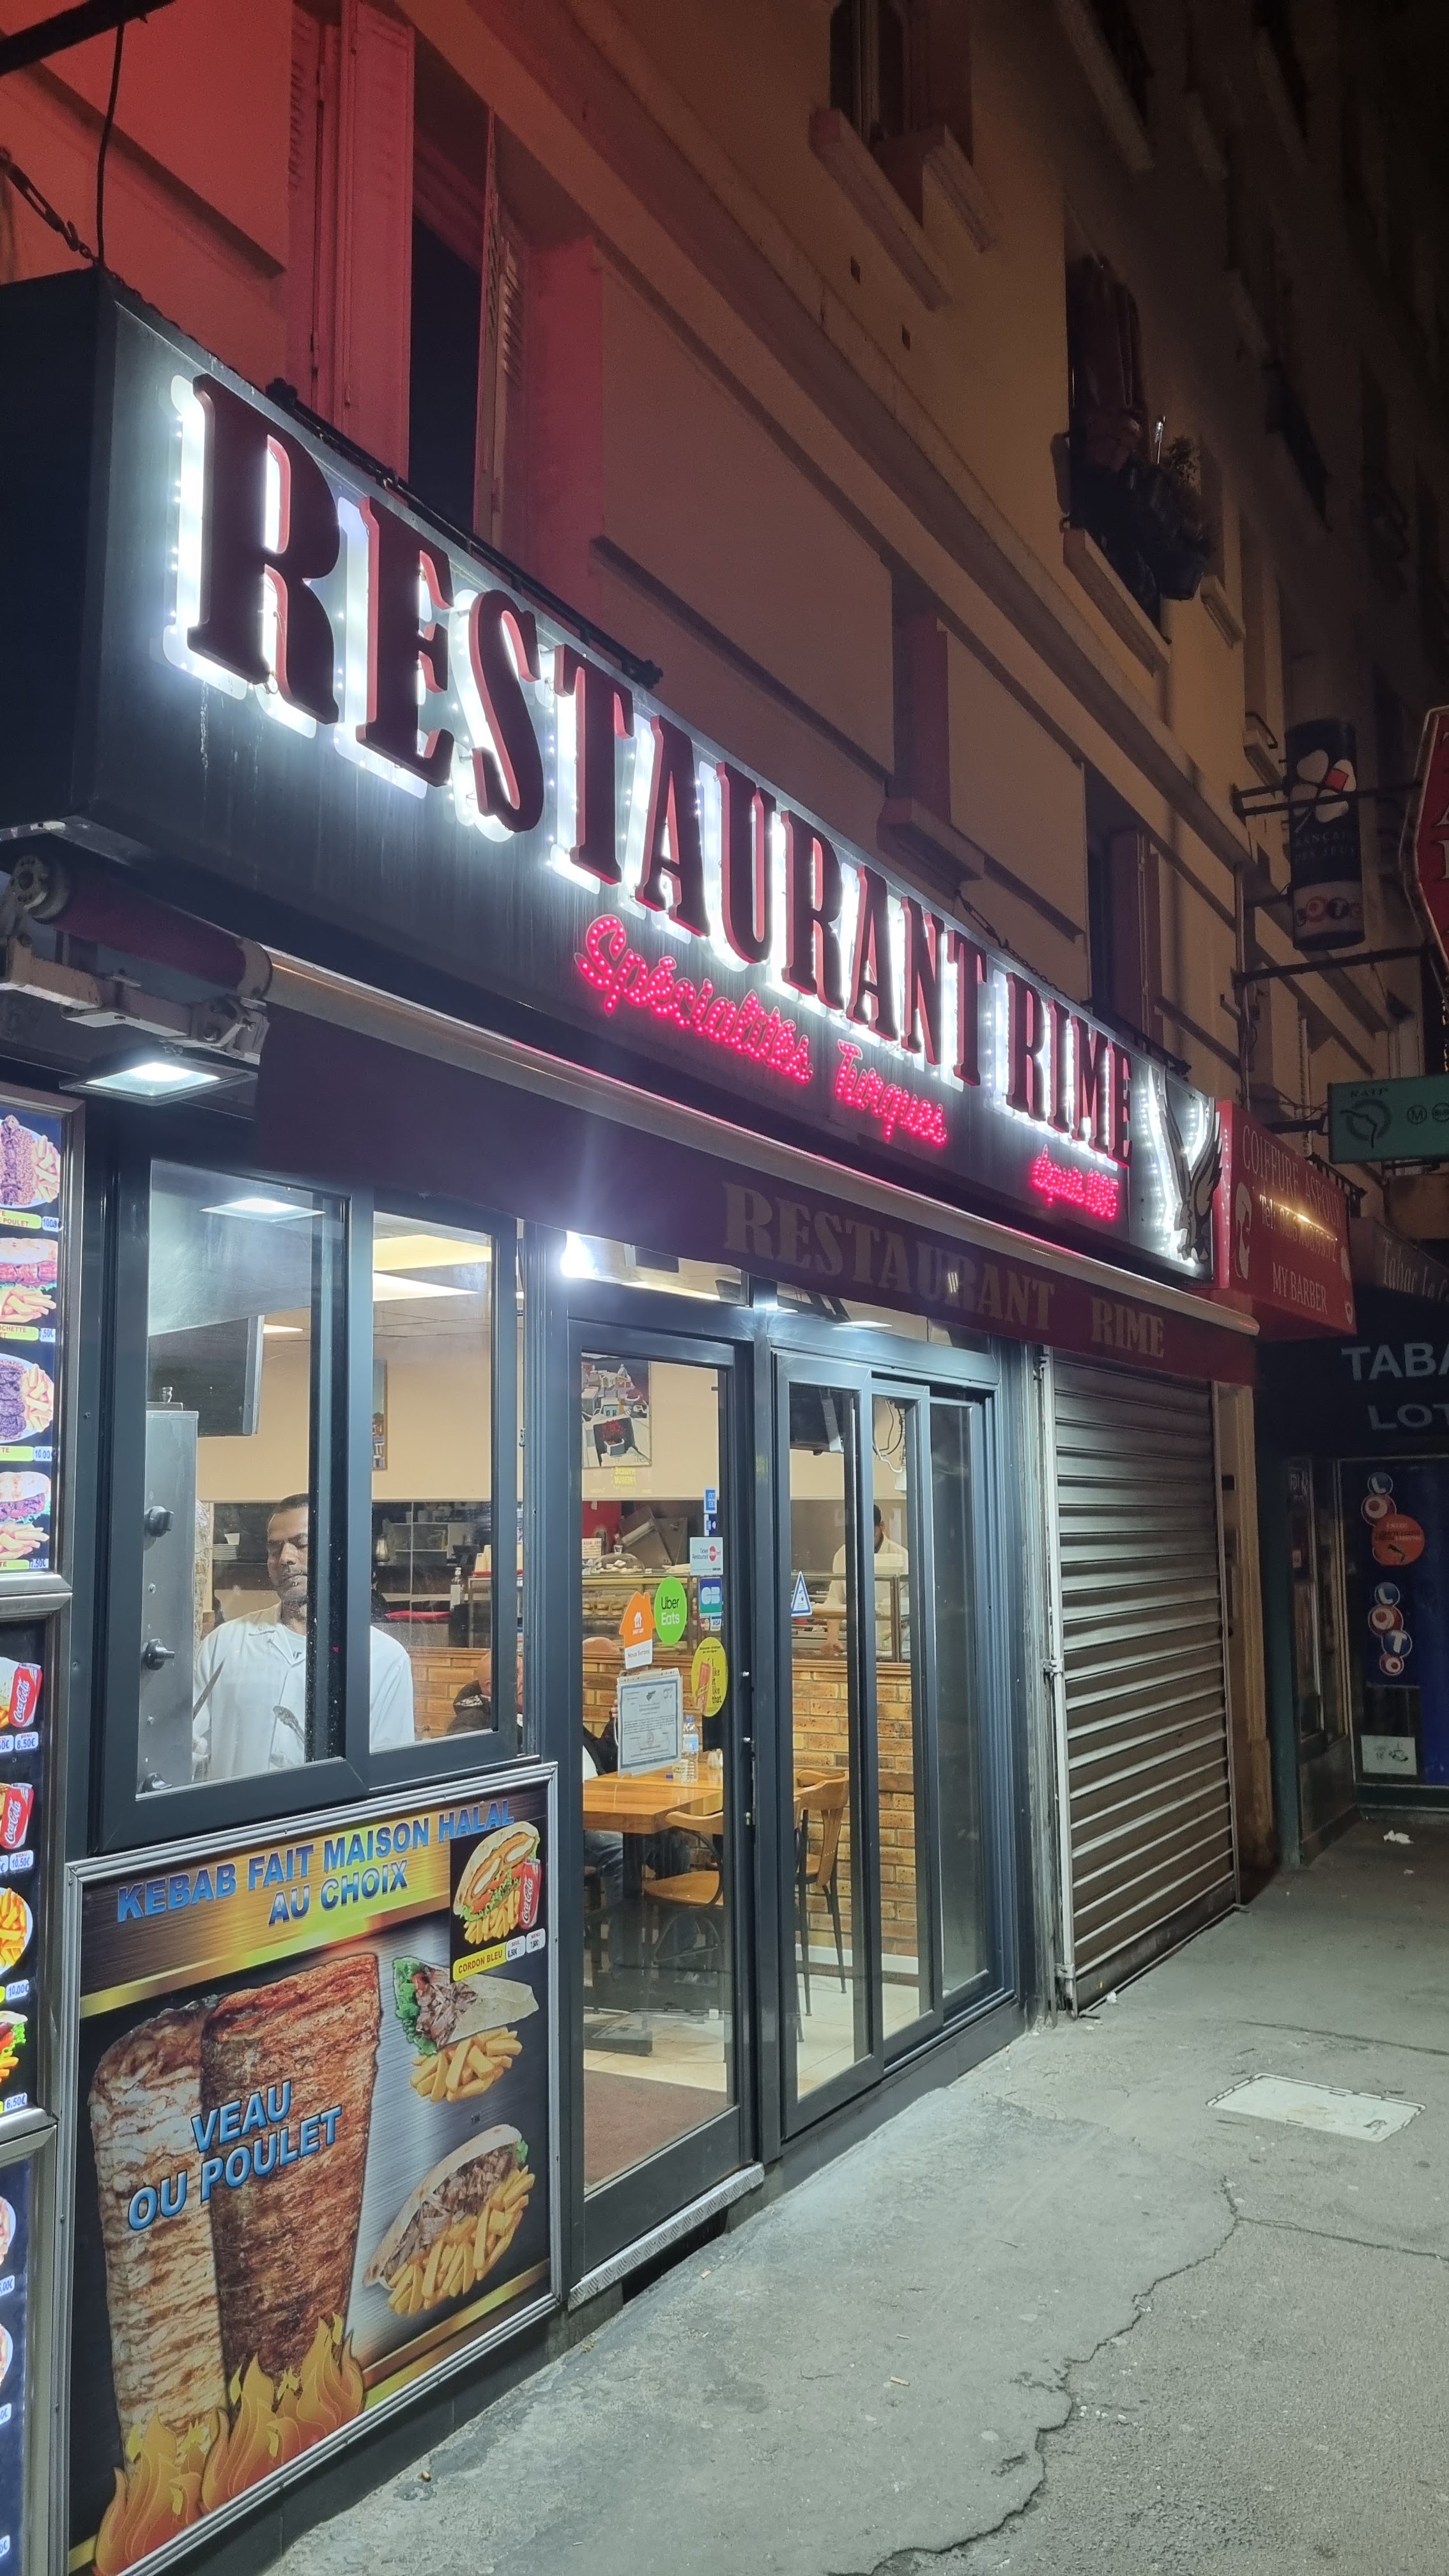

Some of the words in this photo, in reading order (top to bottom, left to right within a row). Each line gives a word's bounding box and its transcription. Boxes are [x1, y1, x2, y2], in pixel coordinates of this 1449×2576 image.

[187, 374, 991, 1087] RESTAURANT
[1005, 971, 1133, 1168] RIME
[575, 914, 813, 1084] Spécialités
[836, 1038, 948, 1147] Turques
[1243, 1125, 1299, 1201] COIFFURE
[3, 1218, 29, 1227] POULET
[723, 1181, 1055, 1332] RESTAURANT
[1091, 1296, 1165, 1359] RIME
[1272, 1262, 1287, 1298] MY
[1291, 1271, 1328, 1314] BARBER
[661, 1597, 680, 1609] Uber
[661, 1612, 680, 1626] Eats
[702, 1587, 720, 1605] CB
[116, 1862, 237, 1923] KEBAB
[247, 1844, 314, 1892] FAIT
[323, 1817, 429, 1872] MAISON
[438, 1798, 515, 1841] HALAL
[268, 1890, 310, 1928] AU
[320, 1860, 408, 1910] CHOIX
[458, 1954, 486, 1974] CORDON
[487, 1949, 503, 1963] BLEU
[190, 2080, 293, 2154] VEAU
[127, 2178, 187, 2231] OU
[199, 2106, 342, 2202] POULET
